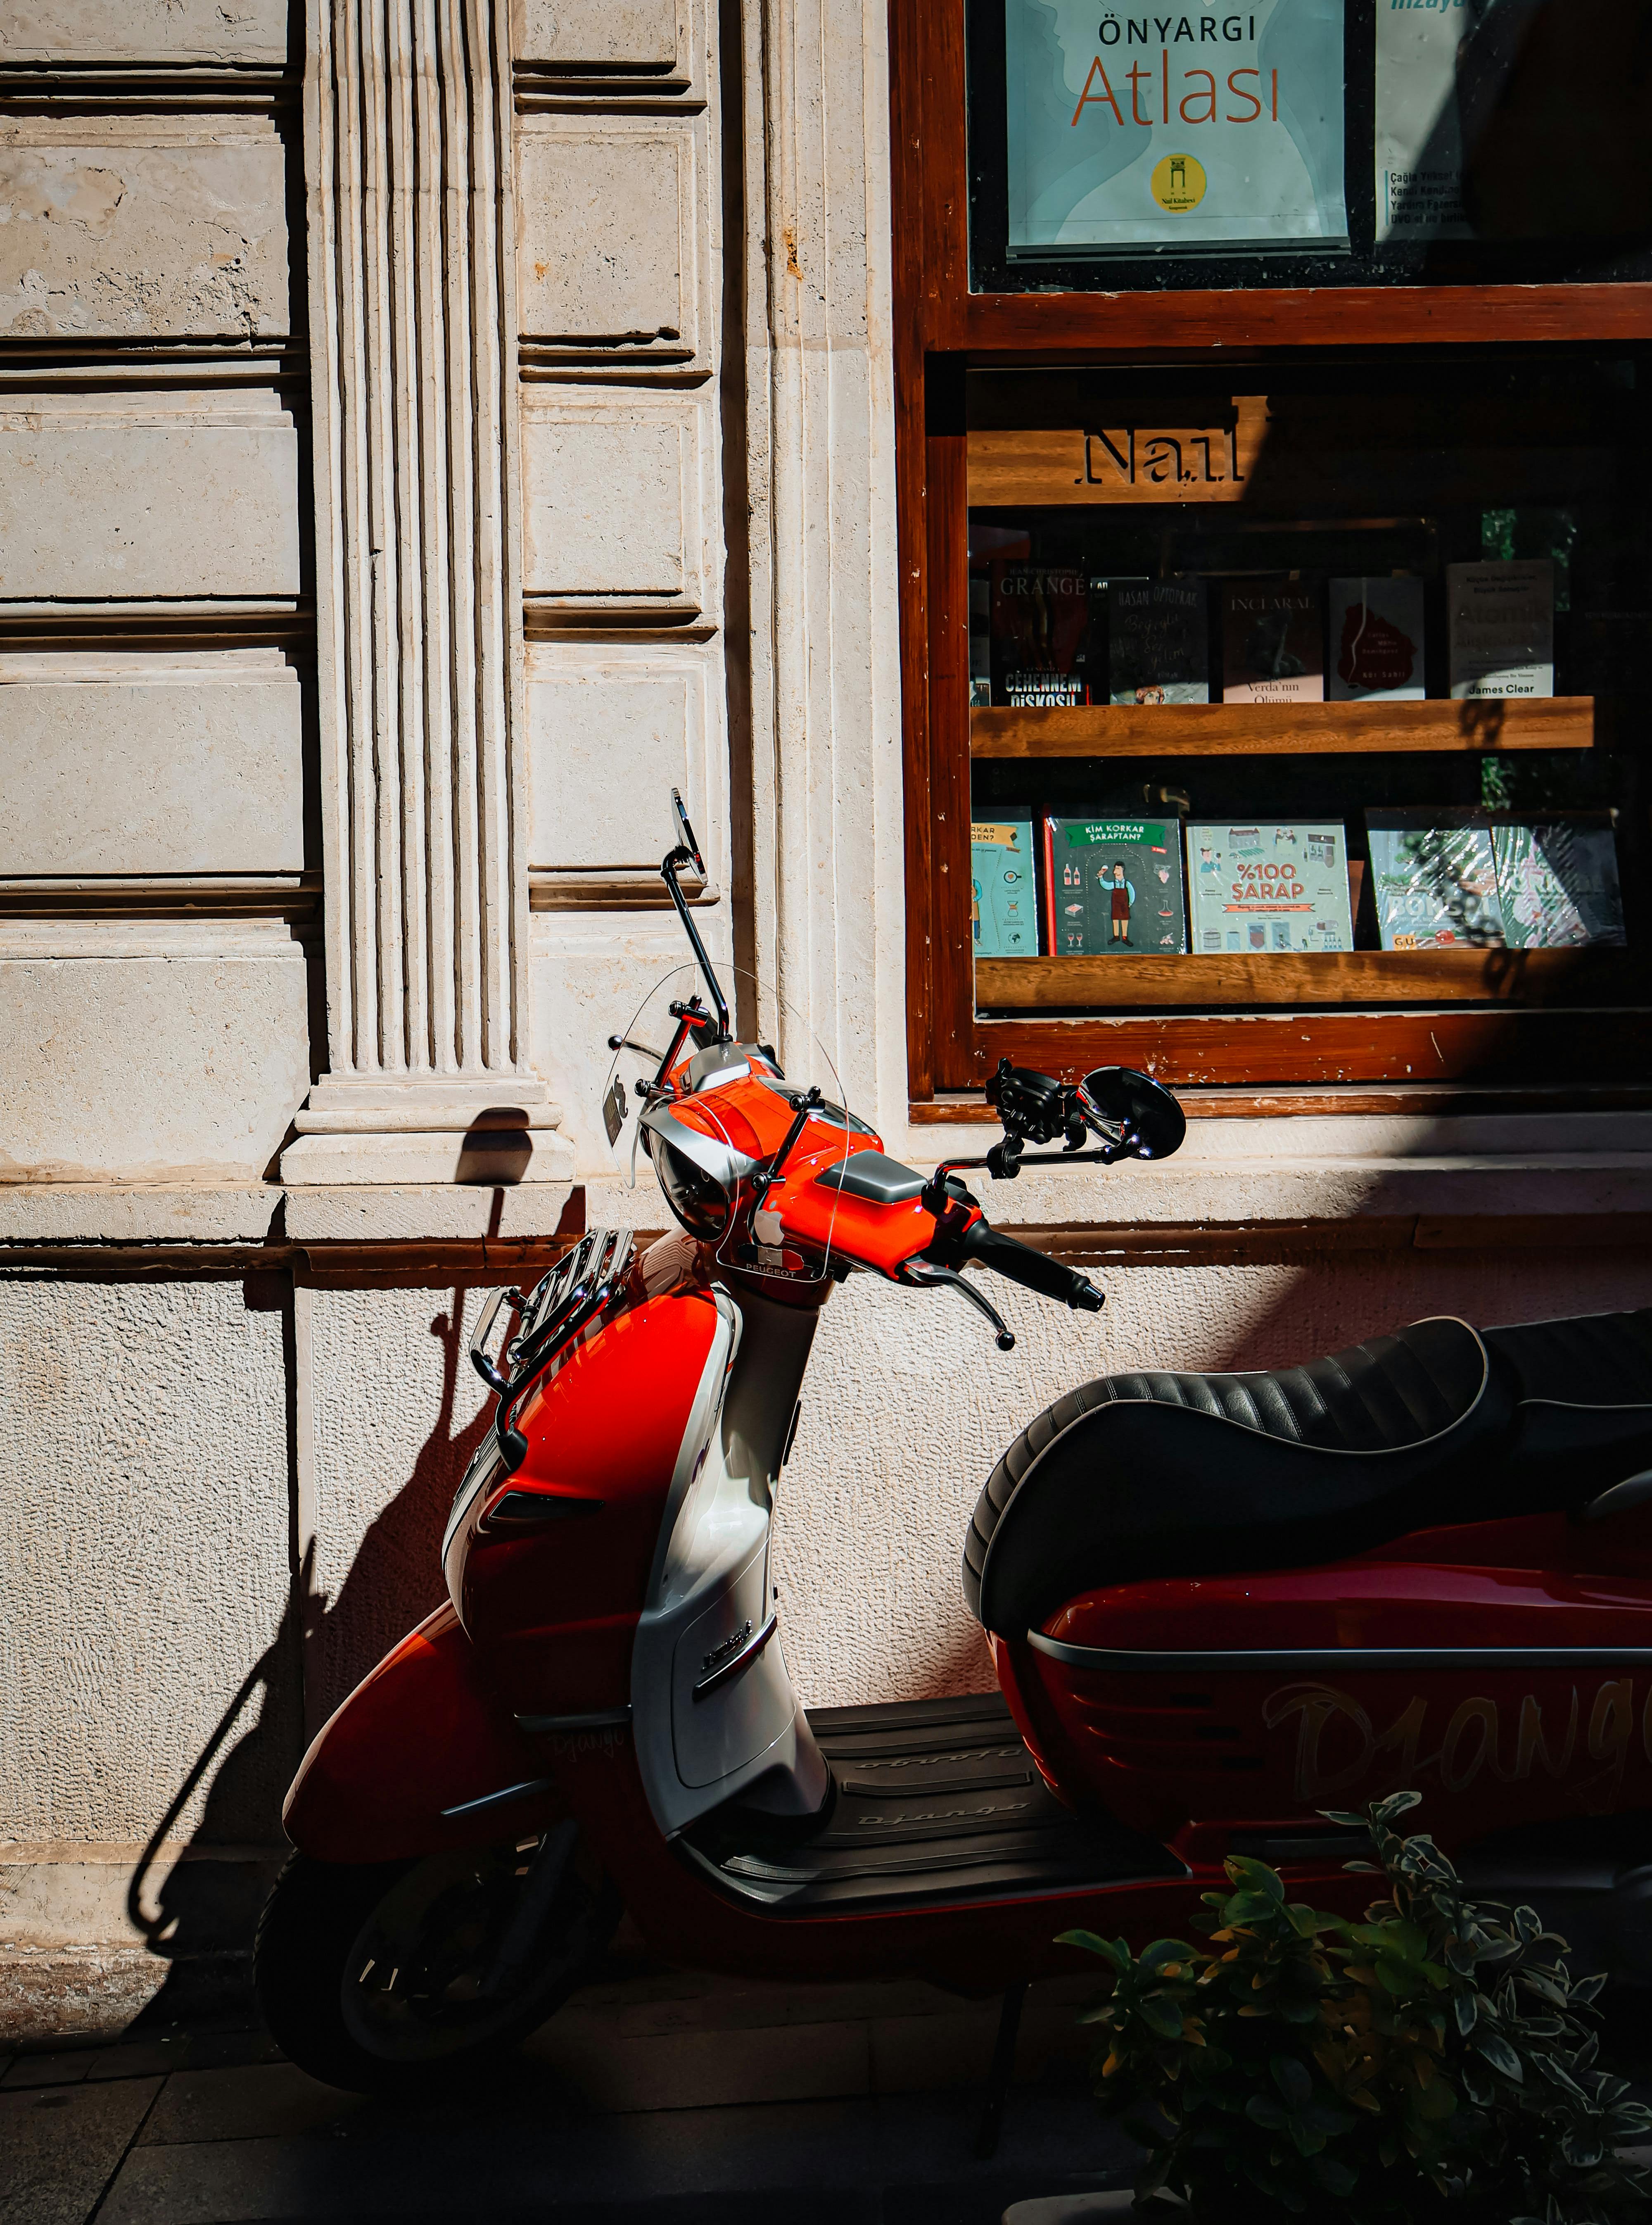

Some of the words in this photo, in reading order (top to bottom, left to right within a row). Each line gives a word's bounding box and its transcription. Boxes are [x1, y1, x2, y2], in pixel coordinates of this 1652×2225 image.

[1099, 13, 1255, 45] ÖNYARGI
[1071, 48, 1277, 126] Atlası
[1390, 173, 1417, 184] Çağla
[1391, 187, 1417, 196] Kendi
[1074, 411, 1244, 483] Nail
[1000, 573, 1086, 595] GRANGÉ
[1118, 590, 1149, 606] HASAN
[1469, 685, 1503, 694] James
[1506, 685, 1534, 693] Clear
[1085, 825, 1103, 834] KİM
[1106, 825, 1144, 833] KORKAR
[1089, 833, 1141, 842] ŞARAPTAN?
[1236, 863, 1296, 880] %100
[1231, 883, 1304, 902] ŞARAP
[746, 1263, 796, 1278] PEUGEOT
[857, 1802, 1032, 1826] Django
